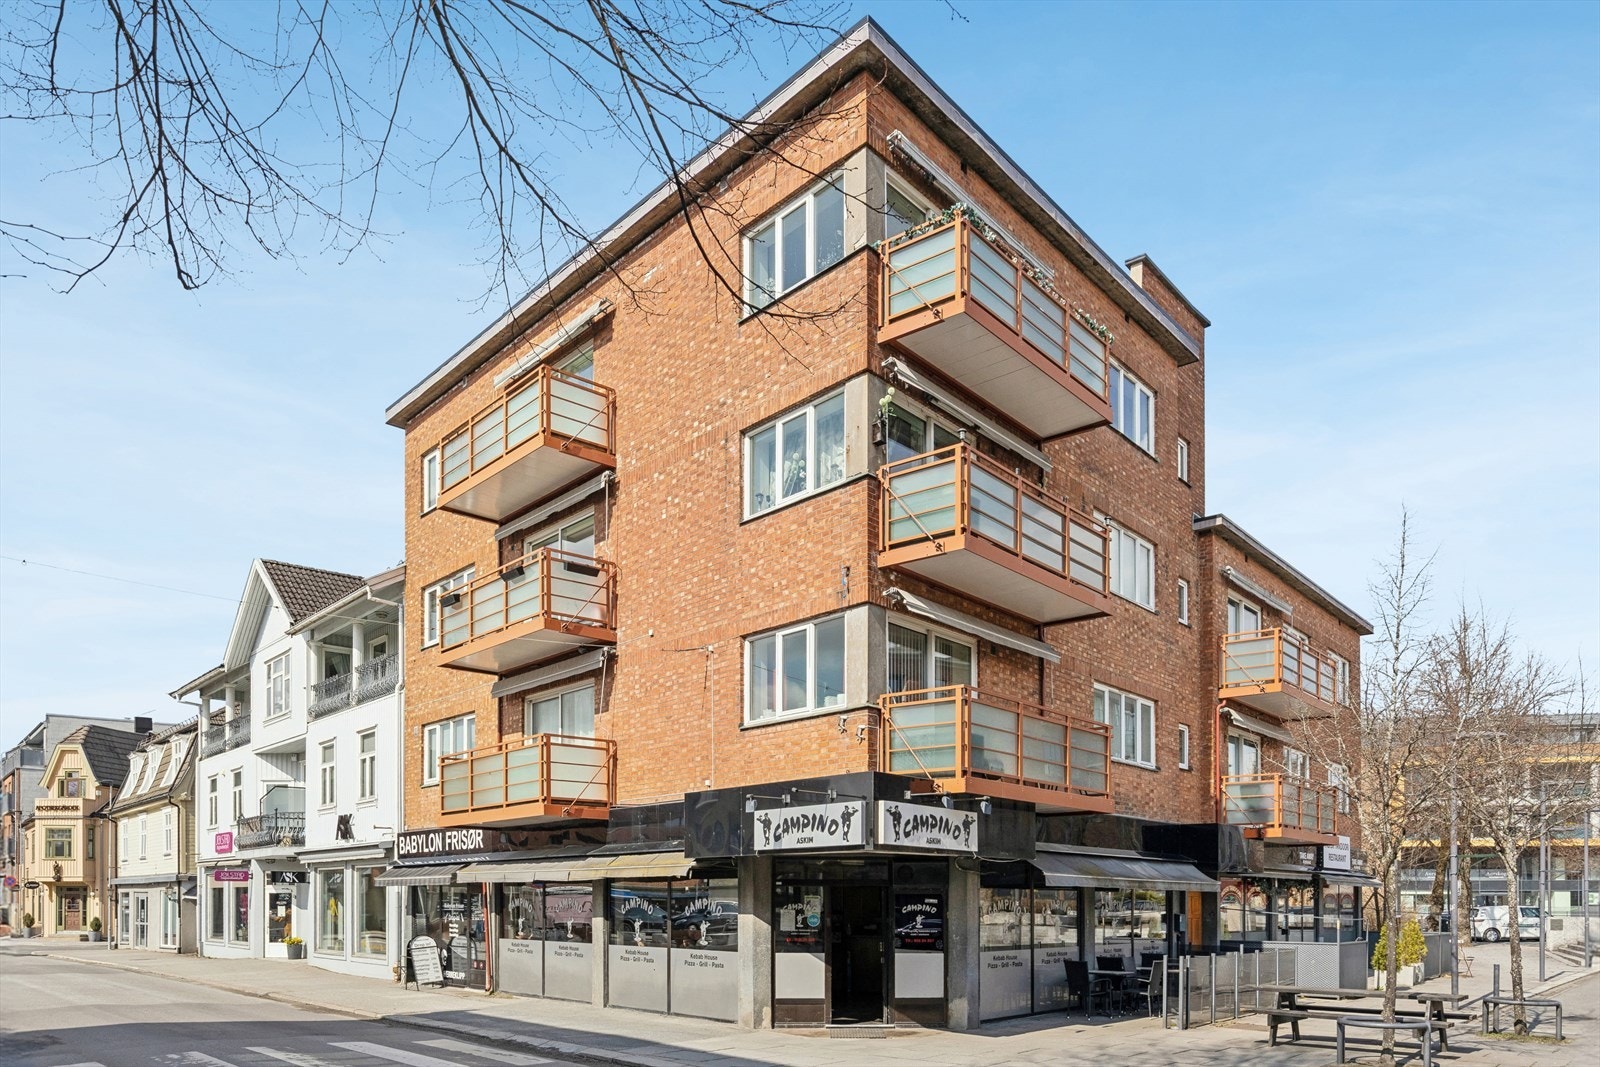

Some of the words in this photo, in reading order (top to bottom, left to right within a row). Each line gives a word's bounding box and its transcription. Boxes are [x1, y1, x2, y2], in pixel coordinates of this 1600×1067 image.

[773, 813, 839, 842] CAMPINO
[903, 814, 961, 840] CAMPINO
[399, 832, 442, 854] BABYLON
[446, 830, 484, 850] FRISØR
[796, 836, 814, 845] ASKIM
[926, 836, 942, 845] ASKIM
[280, 872, 299, 882] ASK
[556, 898, 583, 913] CAMPINO
[620, 898, 654, 914] CAMPINO
[685, 898, 722, 916] CAMPINO
[902, 904, 937, 914] CAMPINO
